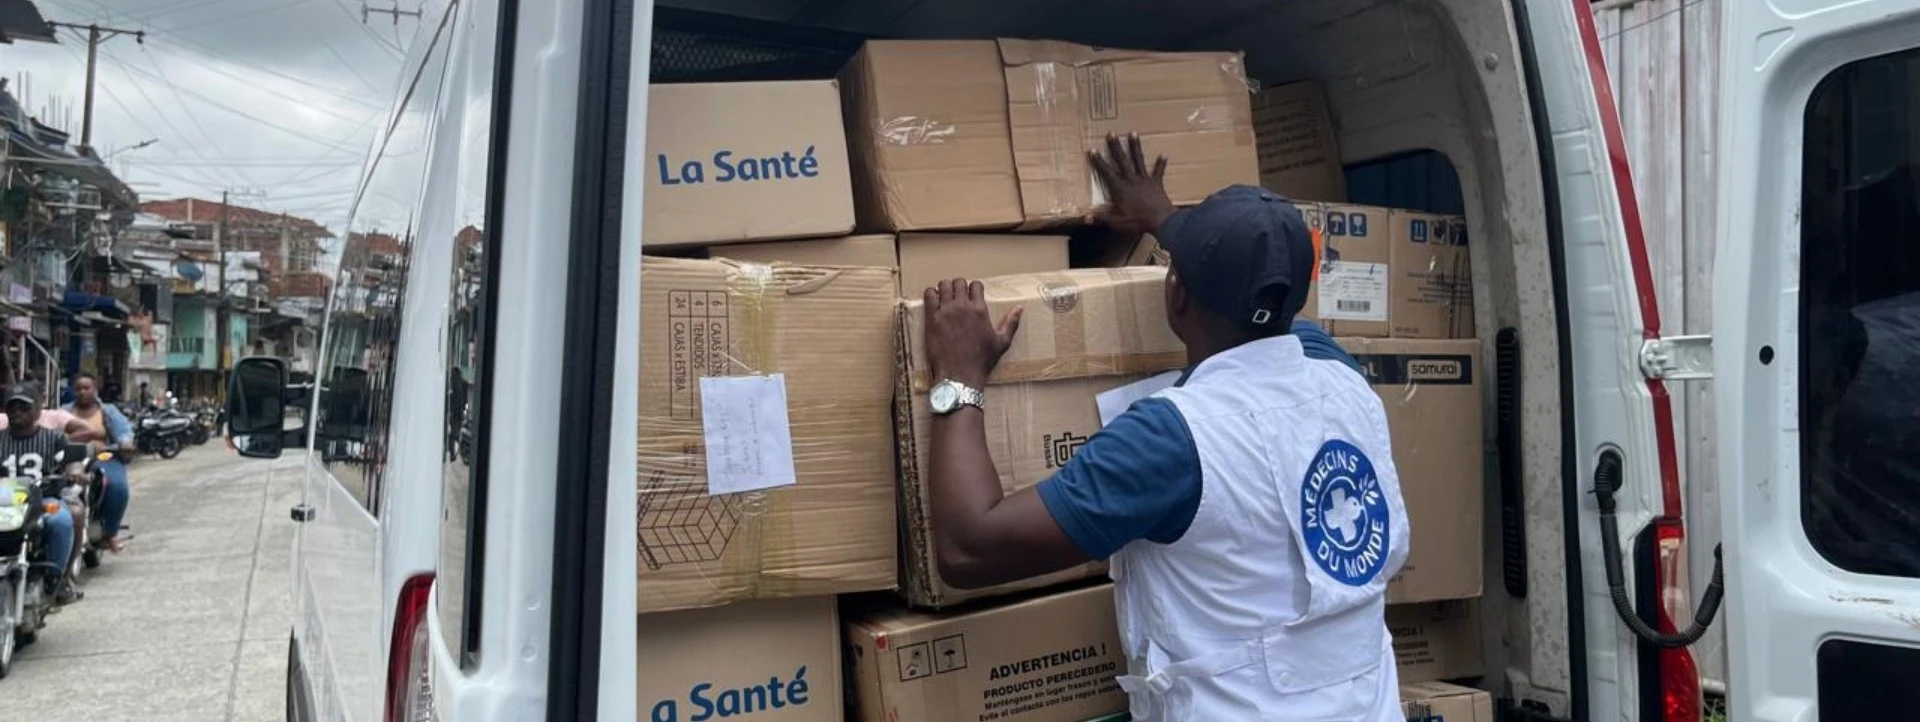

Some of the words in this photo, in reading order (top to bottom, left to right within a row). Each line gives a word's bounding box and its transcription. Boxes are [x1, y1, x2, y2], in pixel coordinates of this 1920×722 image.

[658, 153, 704, 185] La
[713, 145, 819, 182] Santé
[675, 297, 686, 309] 24
[674, 321, 685, 351] CAJAS
[694, 323, 705, 370] TENDIDOS
[711, 323, 722, 351] CAJAS
[674, 360, 686, 391] ESTIBA
[1411, 360, 1458, 374] samurai
[2, 452, 43, 484] 13
[1304, 449, 1359, 529] MÉDECINS
[1317, 540, 1341, 571] DU
[1344, 517, 1384, 578] MONDE
[983, 678, 1043, 699] PRODUCTO
[1046, 661, 1116, 685] PERECEDERO
[989, 645, 1098, 681] ADVERTENCIA
[1101, 643, 1106, 655] !
[651, 699, 677, 722] a
[689, 665, 809, 722] Santé
